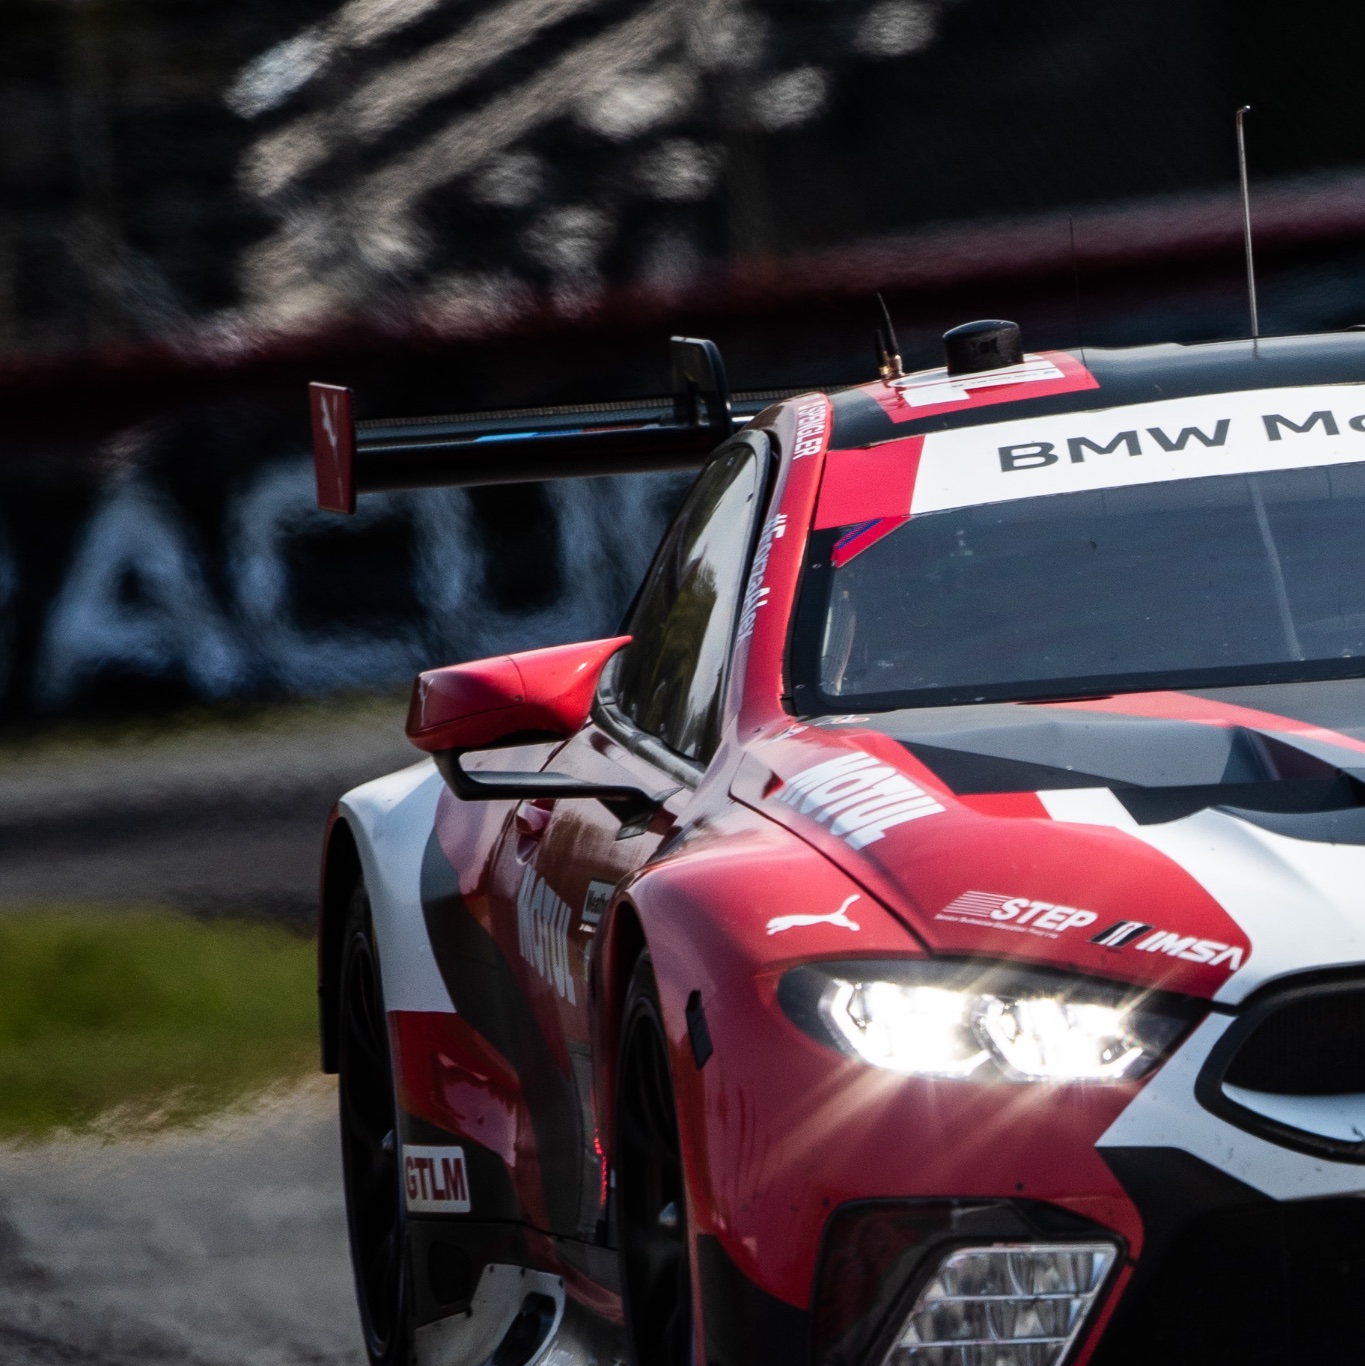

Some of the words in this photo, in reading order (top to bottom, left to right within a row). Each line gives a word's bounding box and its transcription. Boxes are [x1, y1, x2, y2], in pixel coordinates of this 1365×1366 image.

[997, 418, 1232, 473] BMW
[40, 455, 690, 705] ACU
[772, 750, 948, 851] MOTUL
[989, 897, 1099, 932] STEP
[1134, 929, 1244, 971] IMSA
[404, 1155, 467, 1201] GTLM
